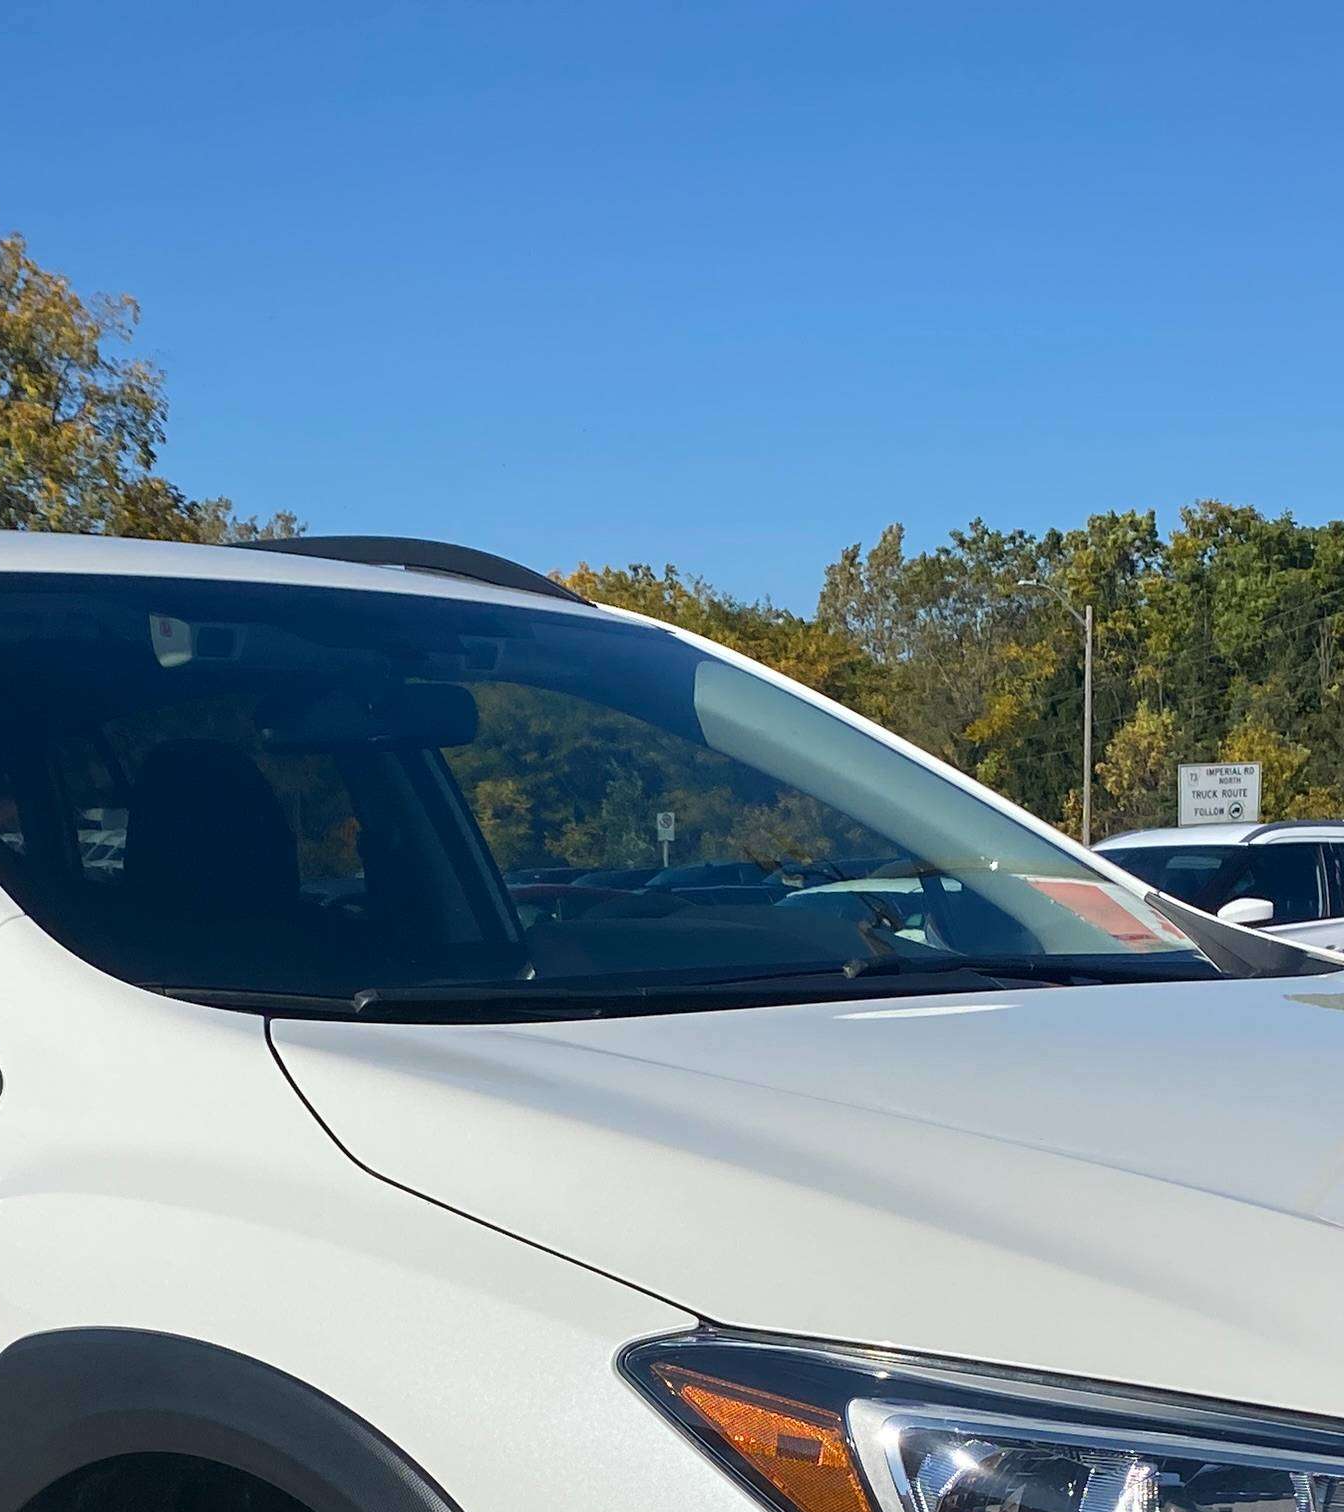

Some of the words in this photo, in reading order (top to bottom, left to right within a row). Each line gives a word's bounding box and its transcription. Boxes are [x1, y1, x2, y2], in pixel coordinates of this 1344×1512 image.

[1206, 767, 1242, 776] IMPERIAL
[1243, 766, 1255, 776] RD
[1218, 777, 1242, 785] NORTH
[1191, 790, 1218, 799] TRUCK
[1221, 788, 1248, 798] ROUTE
[1194, 807, 1225, 816] FOLLOW
